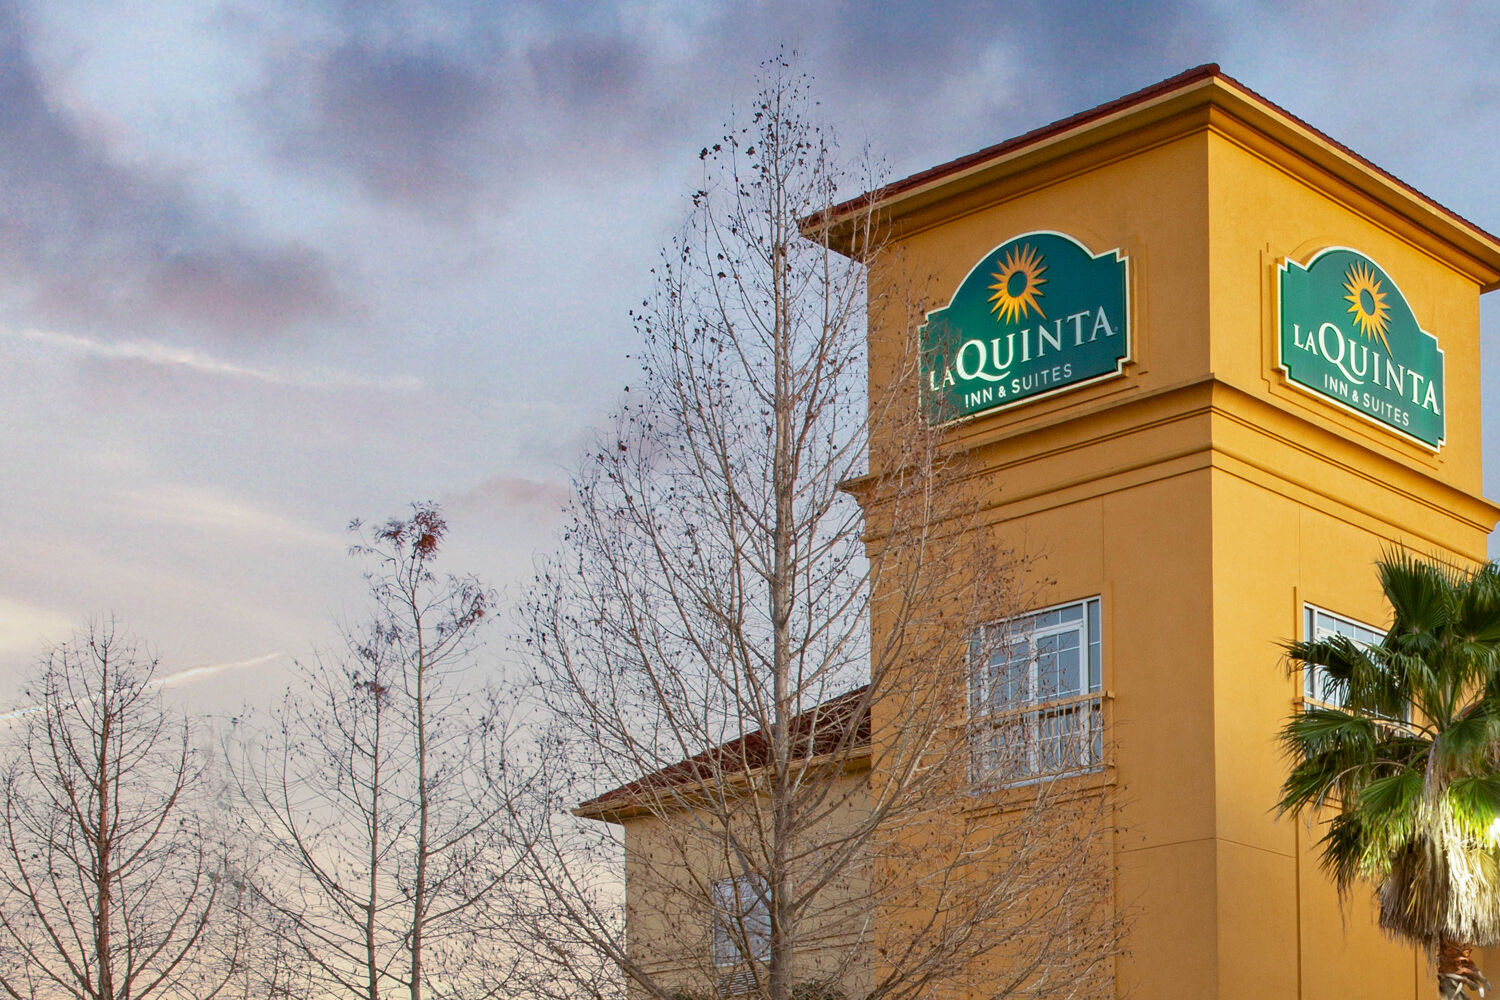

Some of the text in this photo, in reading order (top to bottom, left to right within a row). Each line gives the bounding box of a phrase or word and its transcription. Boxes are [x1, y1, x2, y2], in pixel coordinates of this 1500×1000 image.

[930, 305, 1116, 392] LA QUINTA
[1293, 322, 1441, 416] LA QUINTA
[965, 363, 1072, 409] INN & SUITES
[1324, 373, 1409, 426] INN & SUITES
